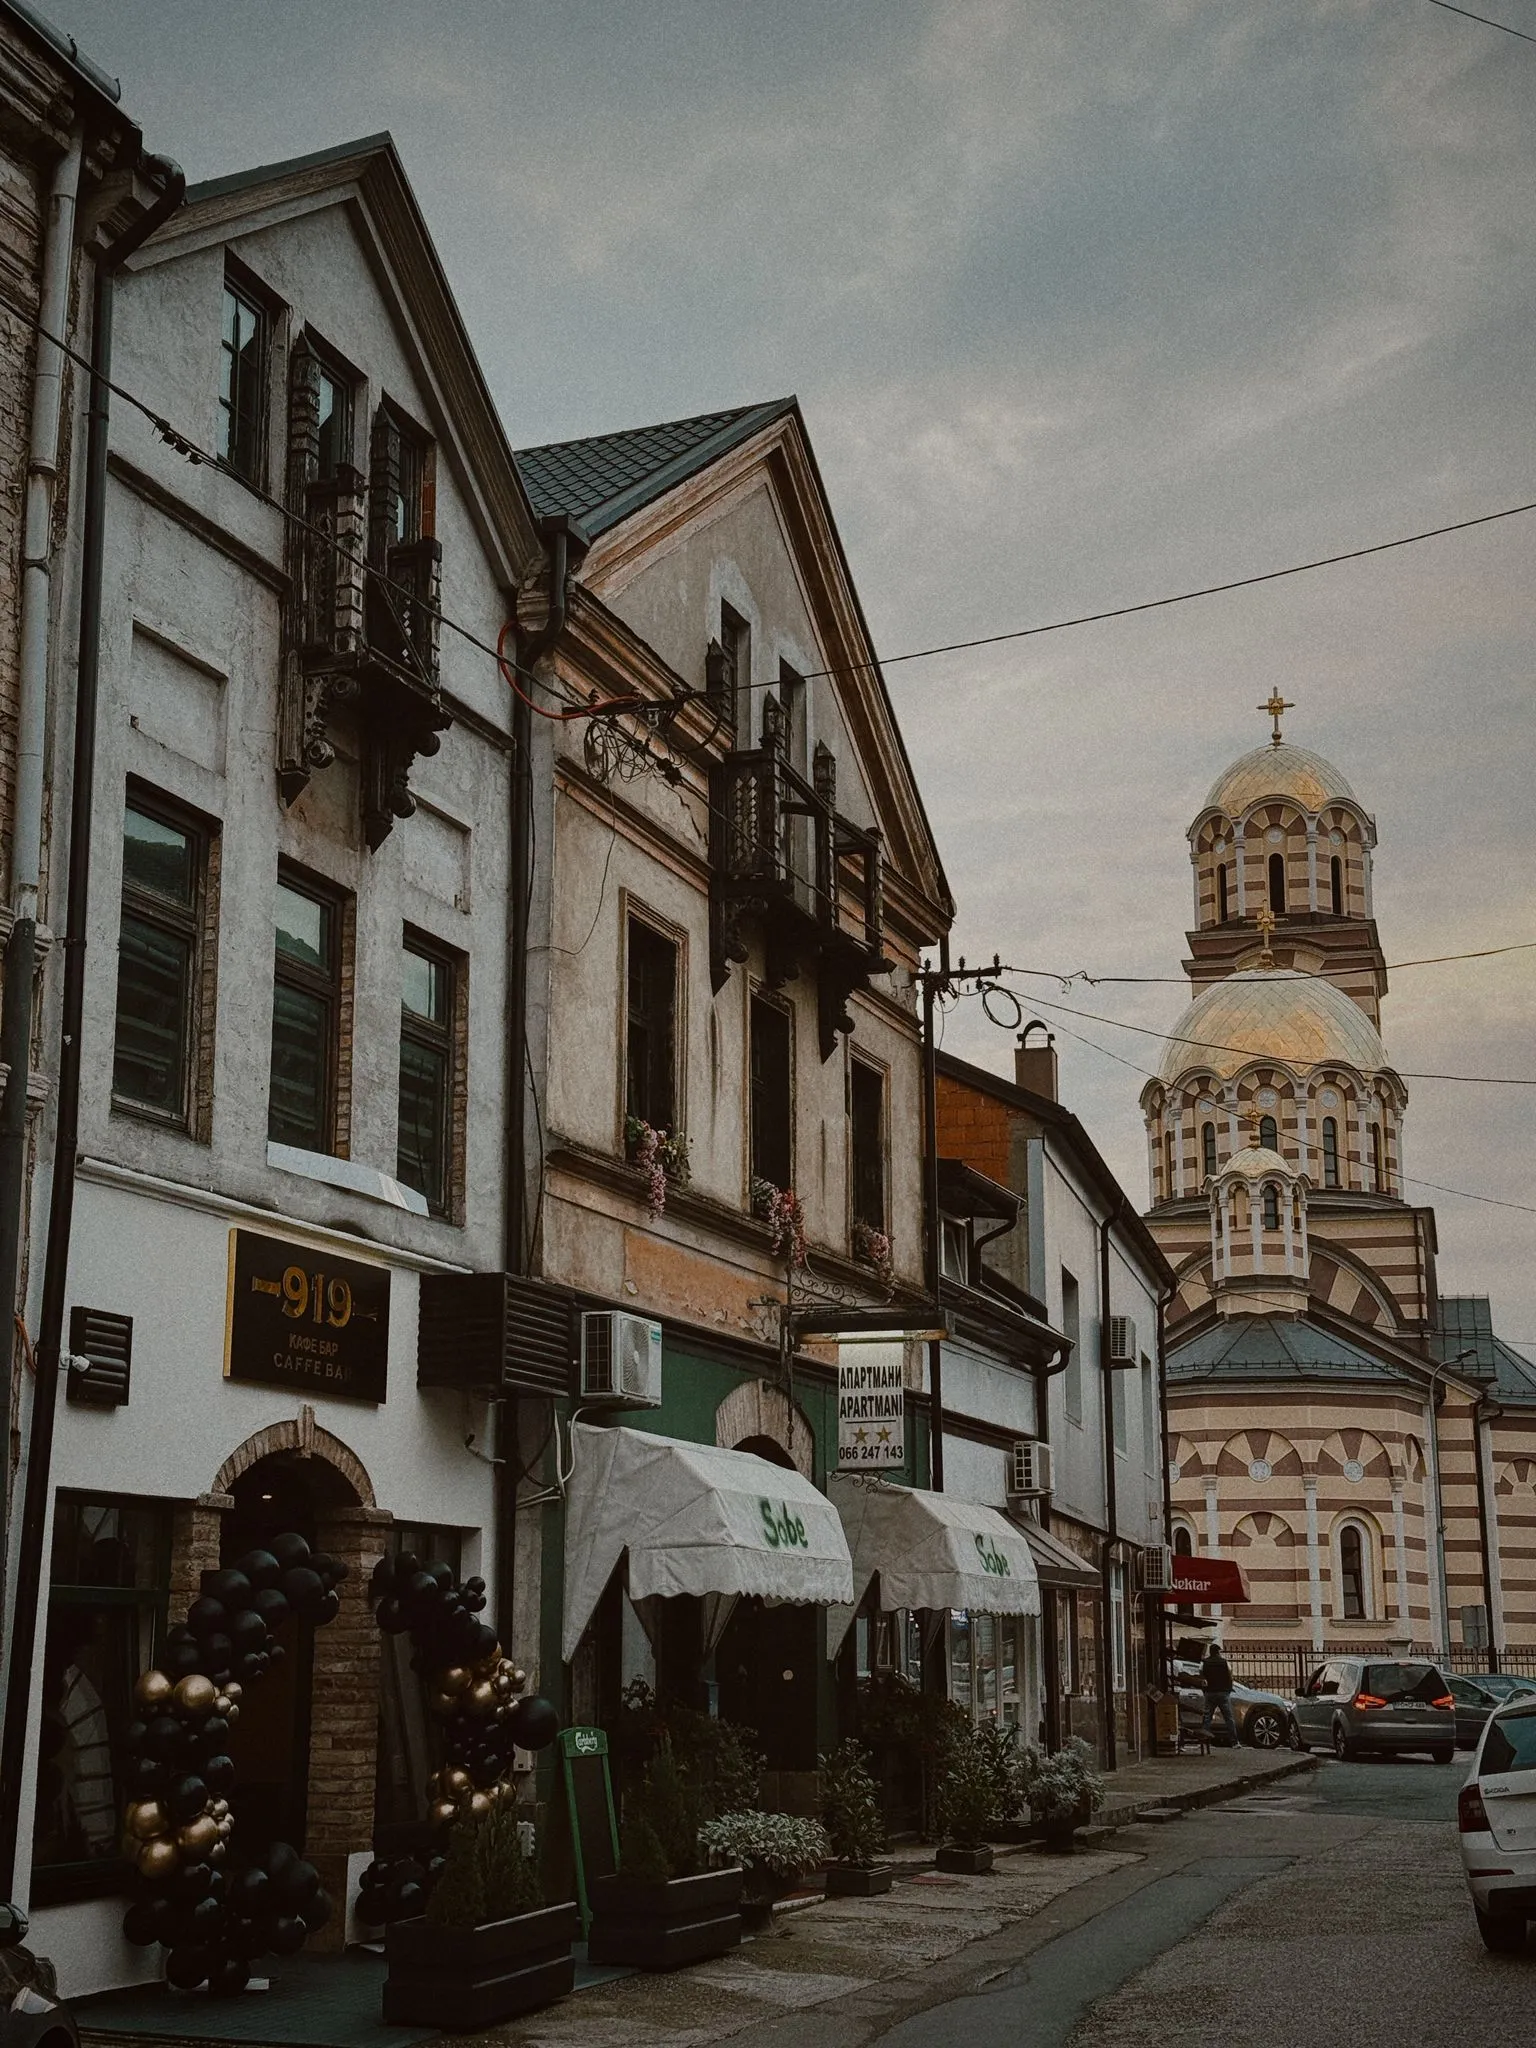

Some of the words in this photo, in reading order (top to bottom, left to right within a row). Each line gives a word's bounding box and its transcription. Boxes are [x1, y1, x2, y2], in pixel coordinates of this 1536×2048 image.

[288, 1332, 318, 1354] КАФЕ
[319, 1340, 339, 1356] БАР
[273, 1352, 322, 1376] CAFFE
[840, 1365, 902, 1389] АПАРТМАНИ
[840, 1394, 902, 1419] APARTMANI
[839, 1446, 859, 1460] 066
[861, 1446, 880, 1460] 247
[884, 1445, 903, 1459] 143
[760, 1497, 809, 1549] Sobe
[975, 1533, 1011, 1577] Sobe
